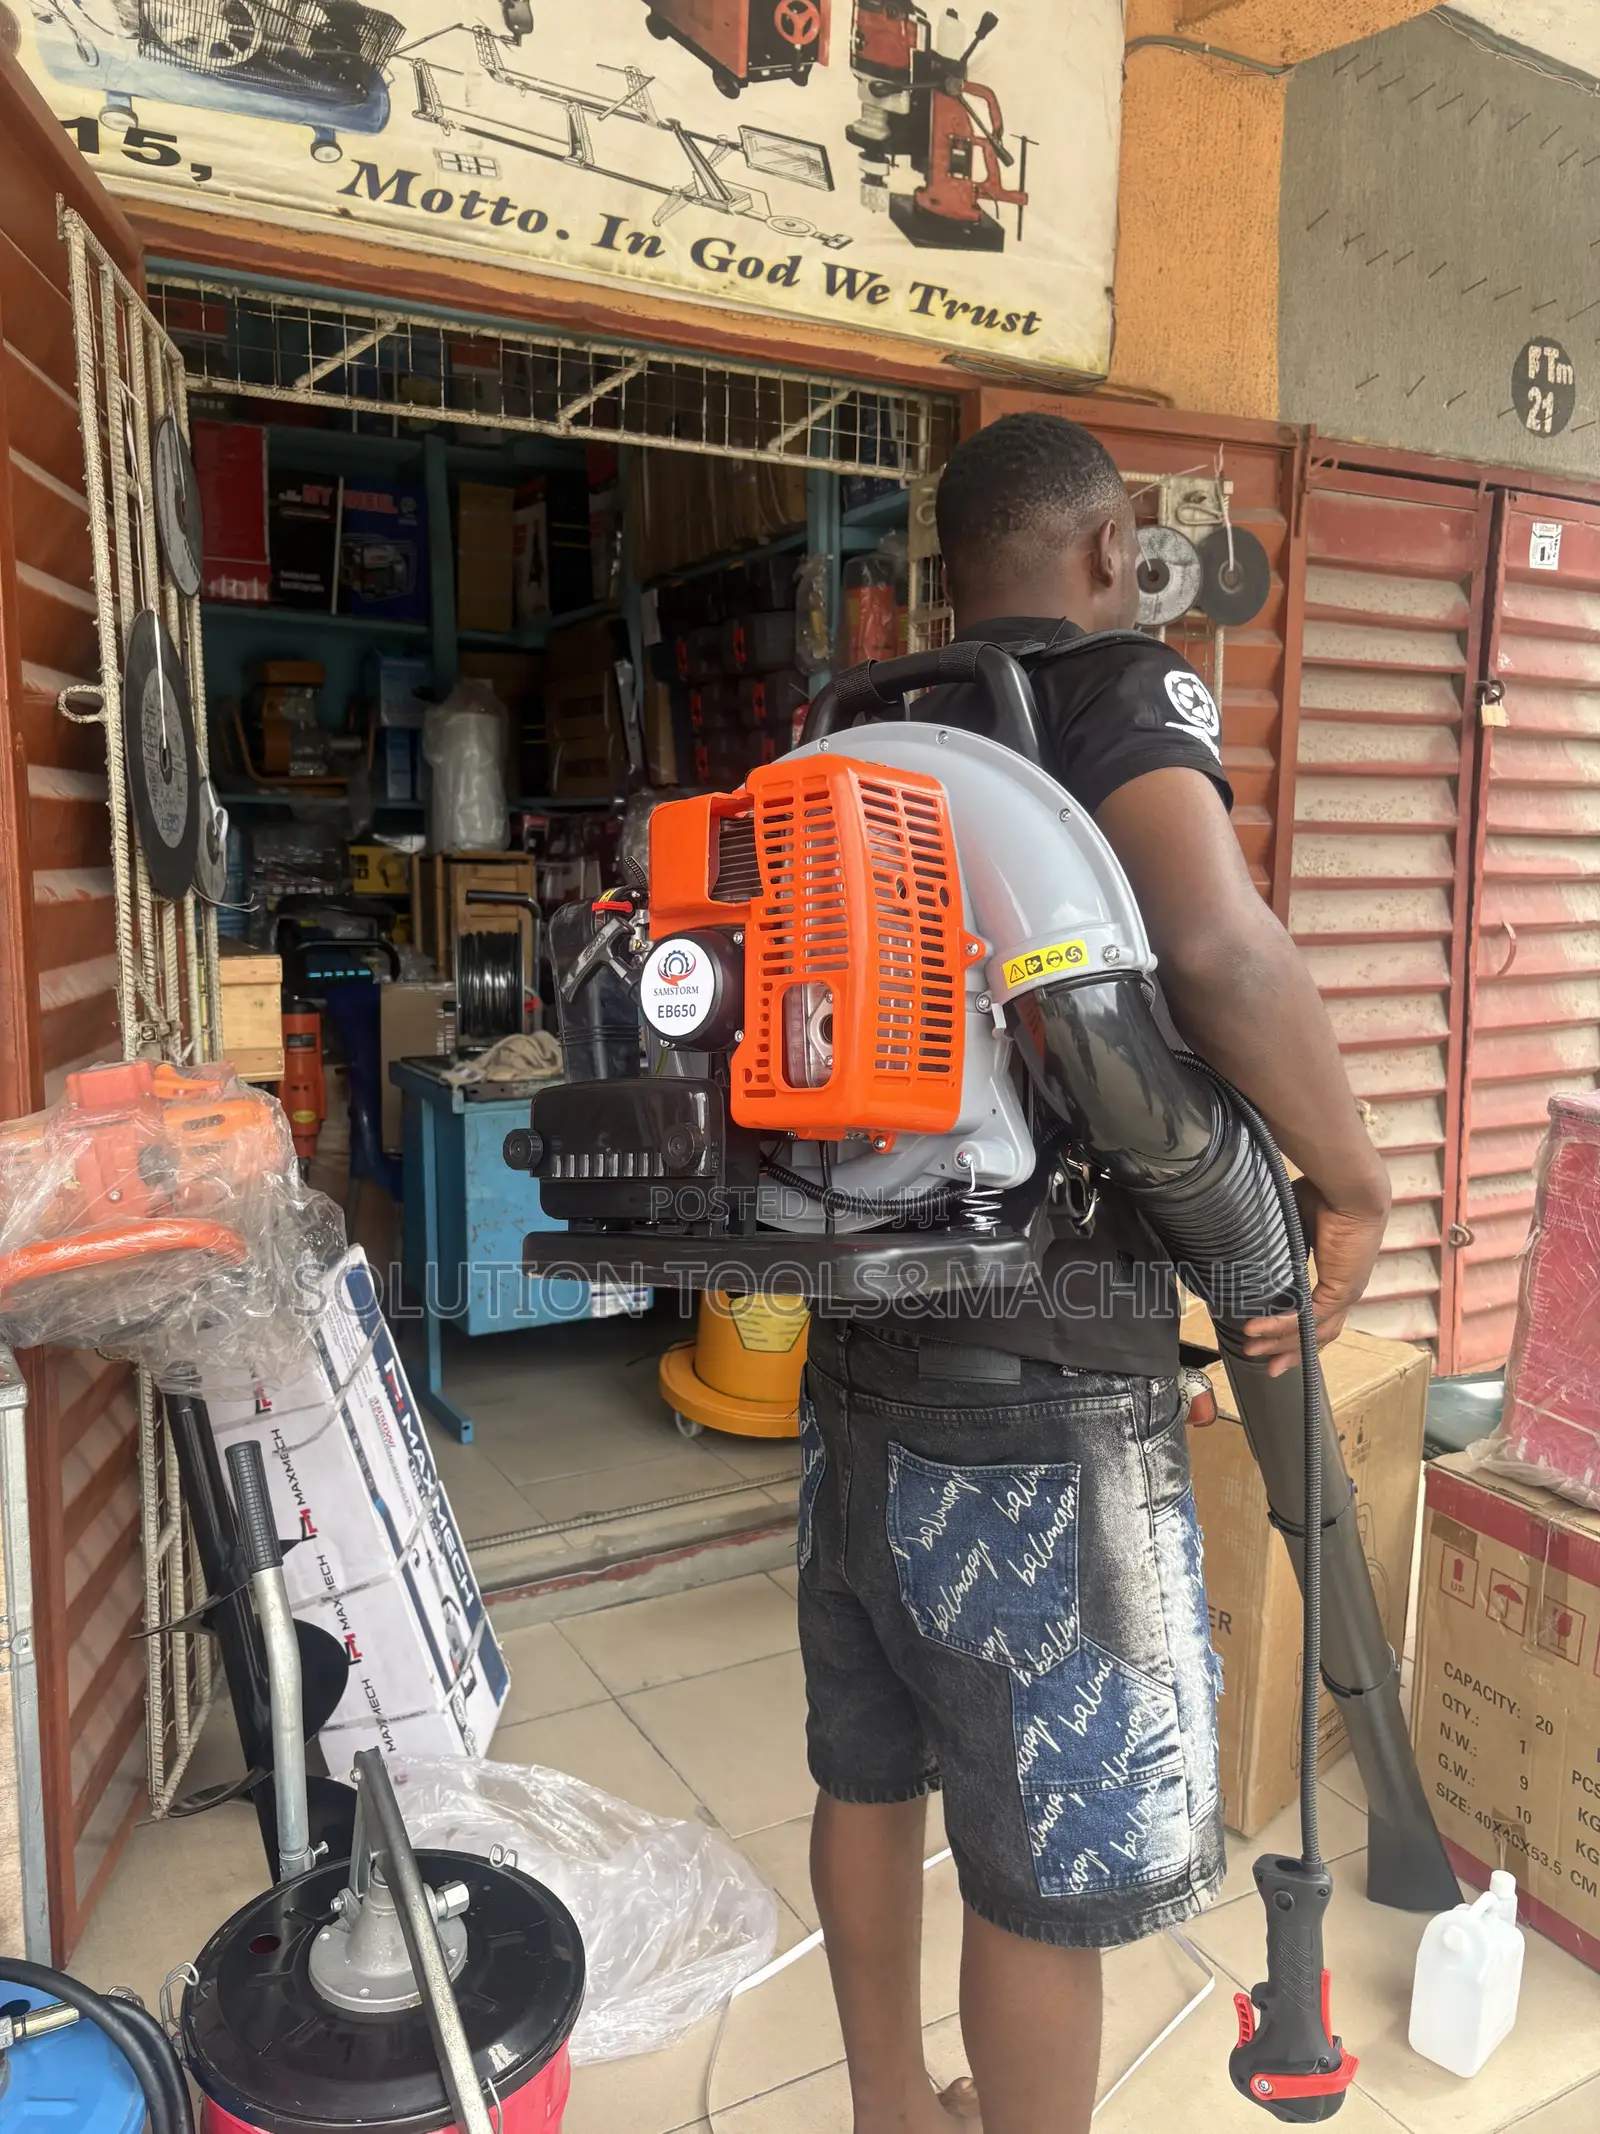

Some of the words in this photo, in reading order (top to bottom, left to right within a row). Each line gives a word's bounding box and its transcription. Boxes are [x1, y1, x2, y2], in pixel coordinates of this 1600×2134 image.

[337, 159, 570, 240] Motto.
[592, 213, 665, 259] In
[690, 236, 802, 288] God
[822, 262, 890, 305] We
[909, 282, 1042, 337] Trust
[1526, 386, 1554, 433] 21
[653, 986, 699, 997] SAMSTORM
[657, 1003, 697, 1019] EB650
[271, 1428, 306, 1506] MAXMECH
[402, 1412, 474, 1608] MAXMECH
[1451, 1581, 1465, 1594] UP
[1442, 1693, 1479, 1727] QTY.:
[1519, 1740, 1527, 1755] 1
[1444, 1661, 1522, 1719] CAPACITY:
[1535, 1714, 1554, 1736] 20
[1438, 1752, 1476, 1788] G.W.:
[1515, 1805, 1532, 1825] 10
[1440, 1721, 1478, 1758] N.W.:
[1519, 1775, 1529, 1791] 9
[1436, 1782, 1472, 1816] SIZE:
[1570, 1868, 1598, 1899] CM
